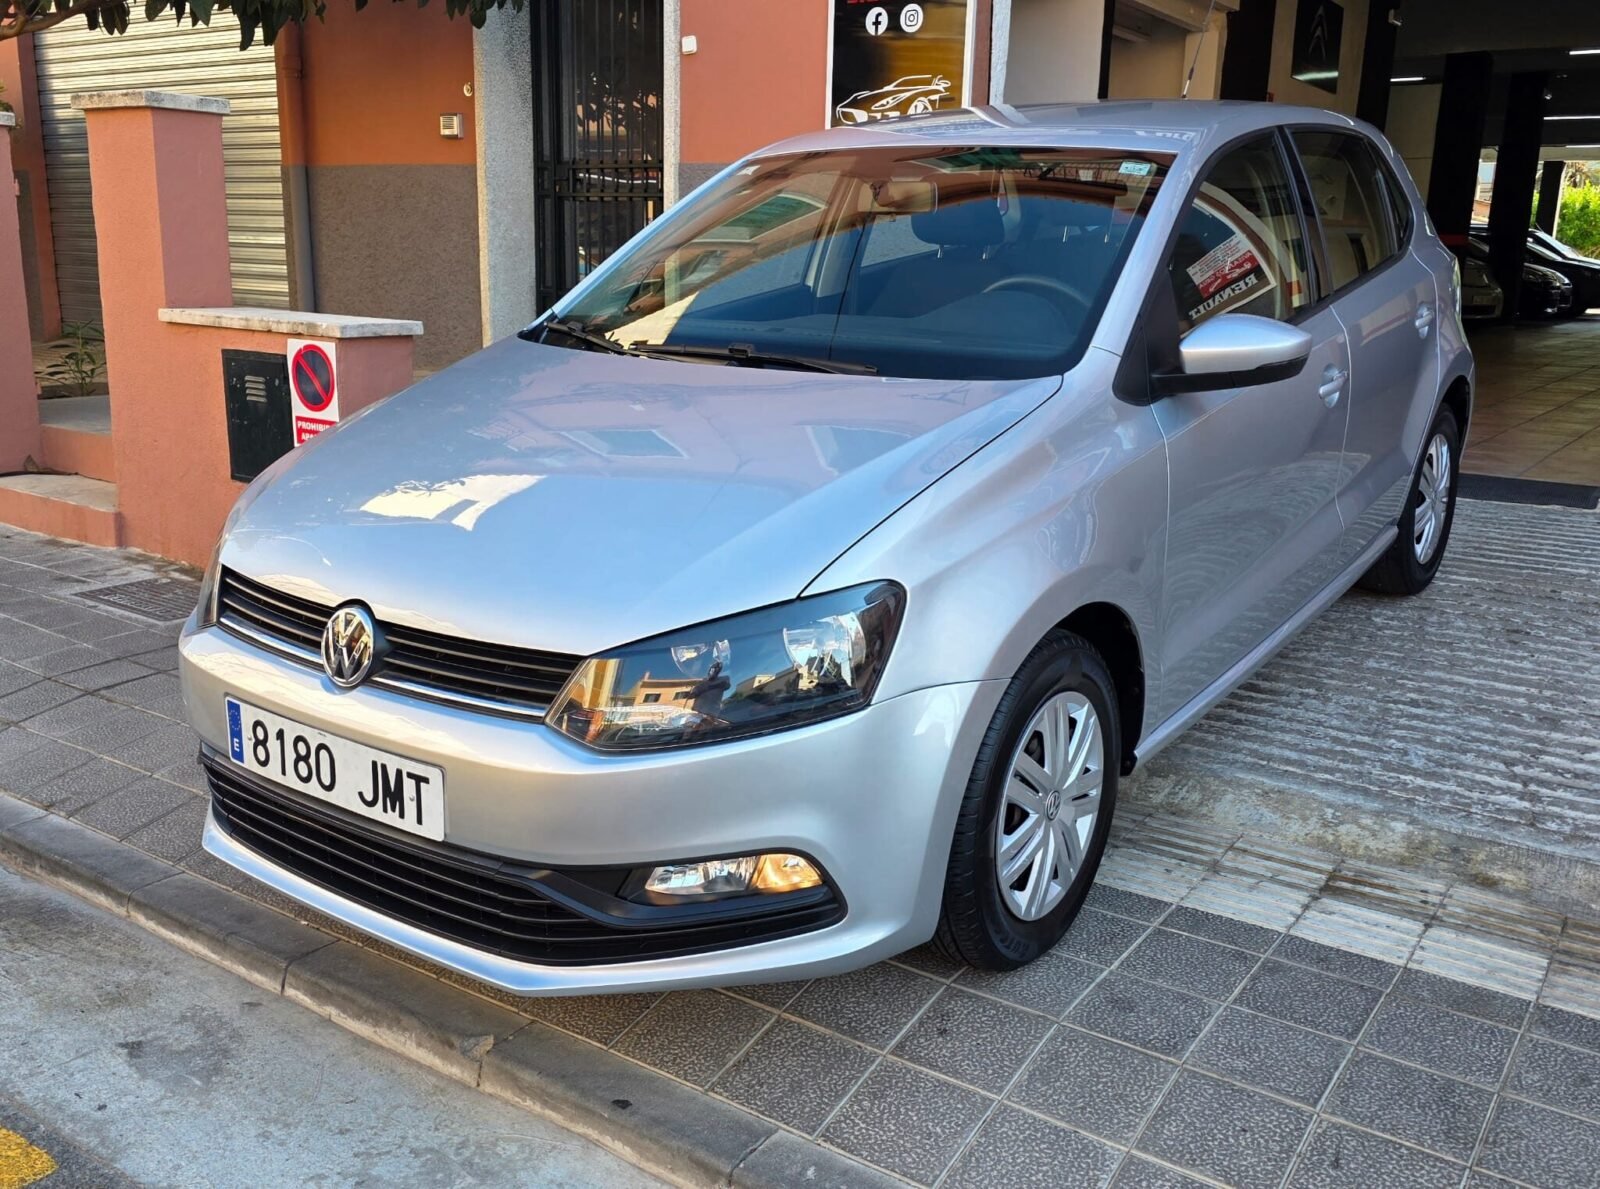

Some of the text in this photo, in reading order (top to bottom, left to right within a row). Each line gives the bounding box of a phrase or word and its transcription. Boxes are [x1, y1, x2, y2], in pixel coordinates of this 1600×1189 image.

[233, 737, 240, 752] E
[252, 719, 430, 826] 8180 JMT
